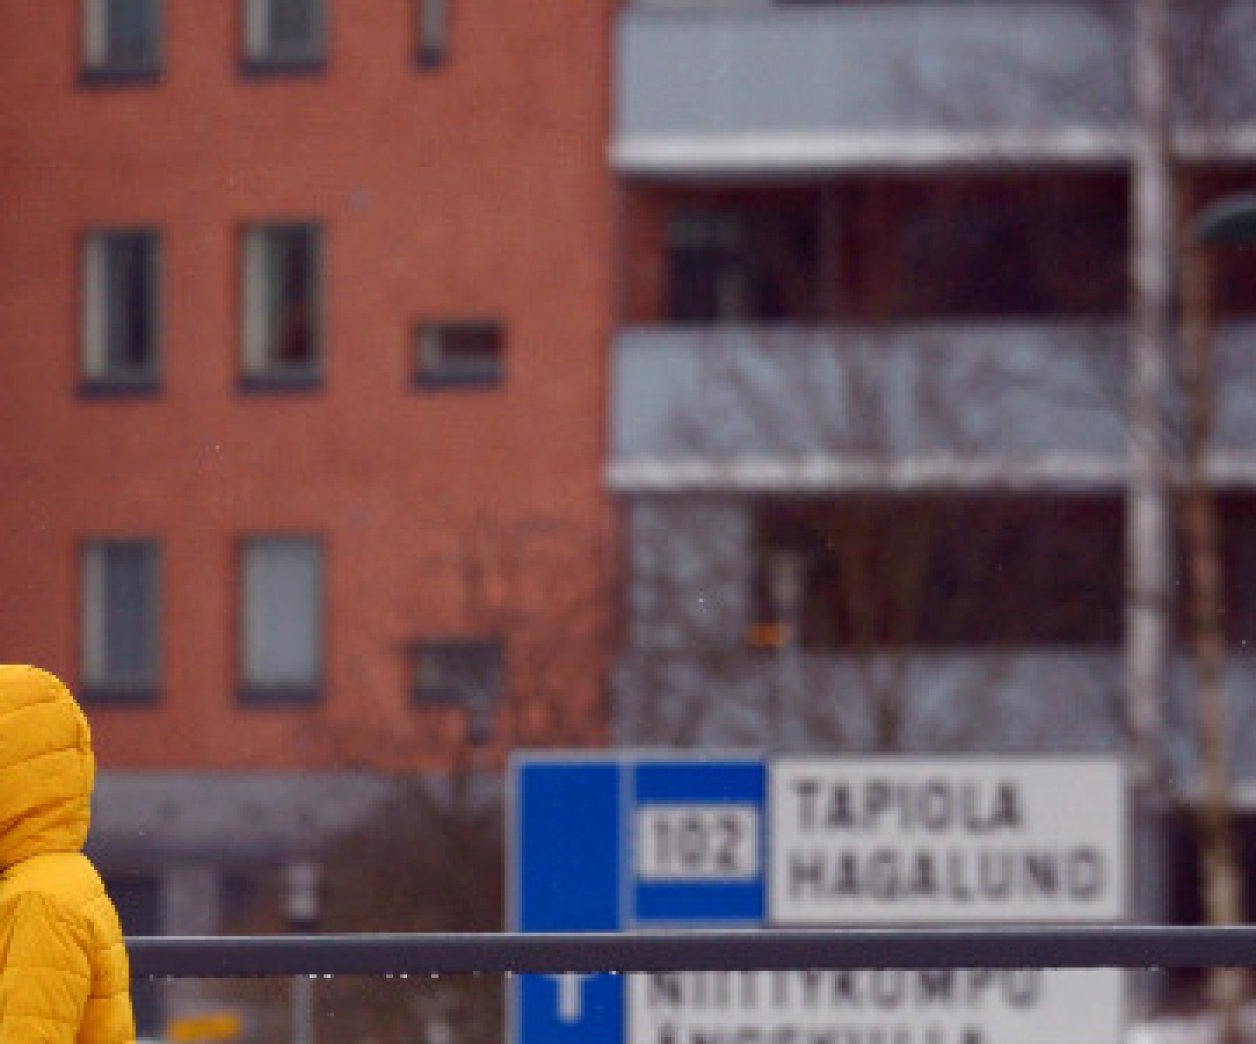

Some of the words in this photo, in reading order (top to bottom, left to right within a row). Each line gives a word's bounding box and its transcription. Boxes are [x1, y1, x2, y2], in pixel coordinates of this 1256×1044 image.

[791, 778, 1025, 834] TAPIOLA
[654, 815, 743, 874] 102
[788, 848, 1106, 902] HAGALUND
